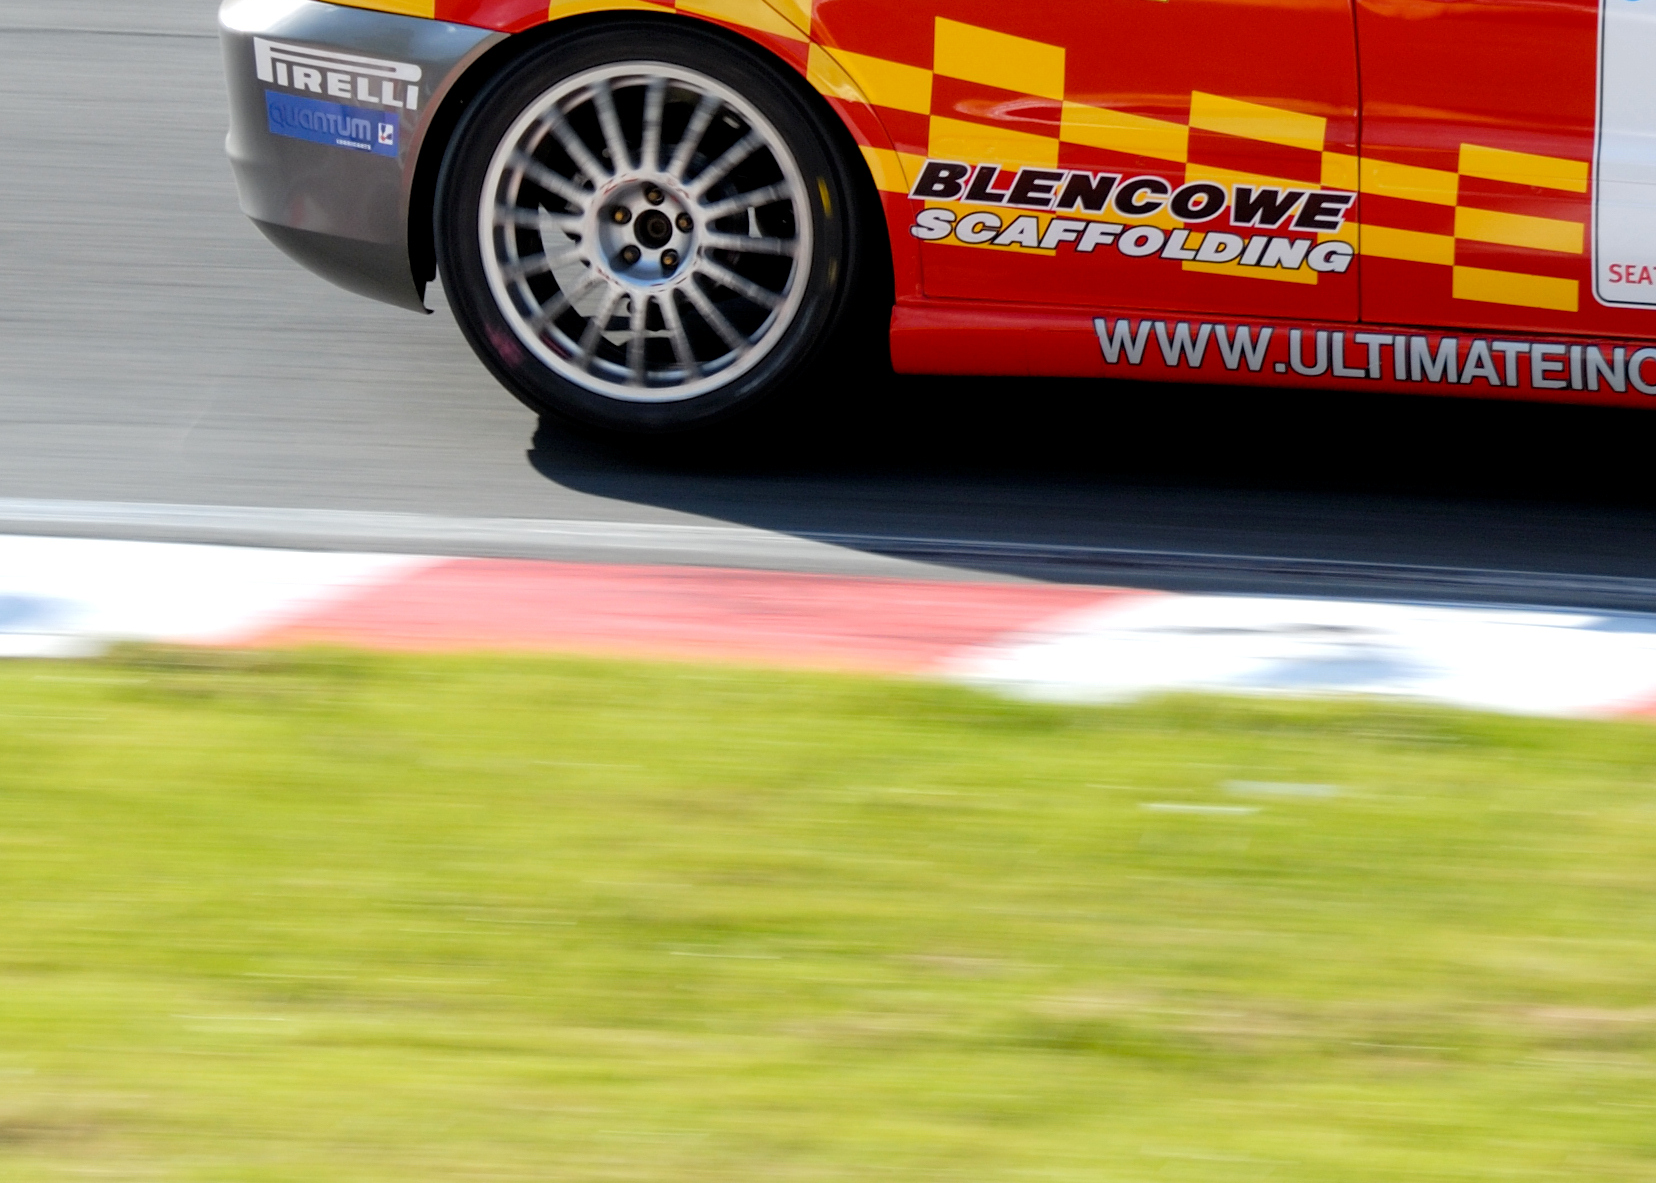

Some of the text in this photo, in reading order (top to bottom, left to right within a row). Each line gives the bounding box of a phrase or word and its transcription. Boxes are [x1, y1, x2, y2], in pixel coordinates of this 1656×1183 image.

[253, 36, 422, 110] PIRELLI
[908, 158, 1358, 234] BLENCOWE
[911, 207, 1355, 275] SCAFFOLDING
